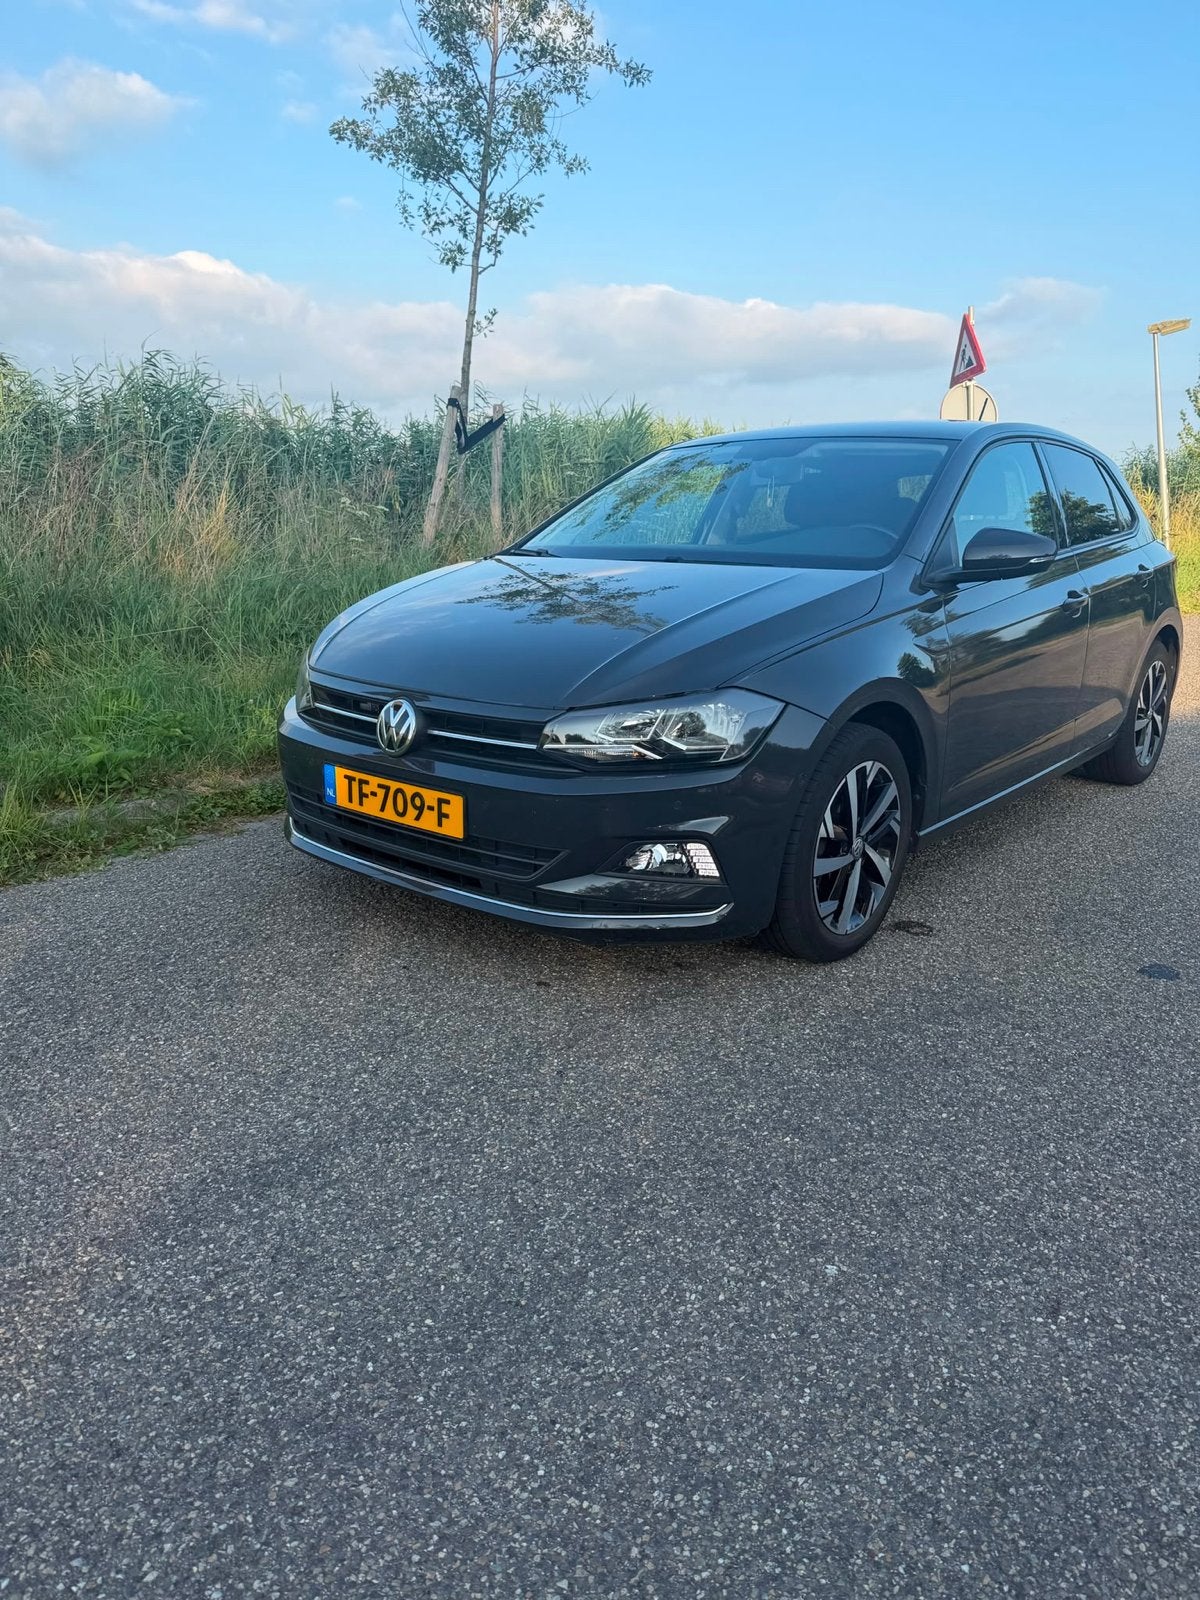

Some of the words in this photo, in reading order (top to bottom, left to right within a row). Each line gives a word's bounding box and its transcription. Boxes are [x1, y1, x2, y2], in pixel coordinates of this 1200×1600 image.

[377, 700, 416, 755] VW
[326, 788, 336, 798] NL
[343, 774, 451, 828] TF-709-F
